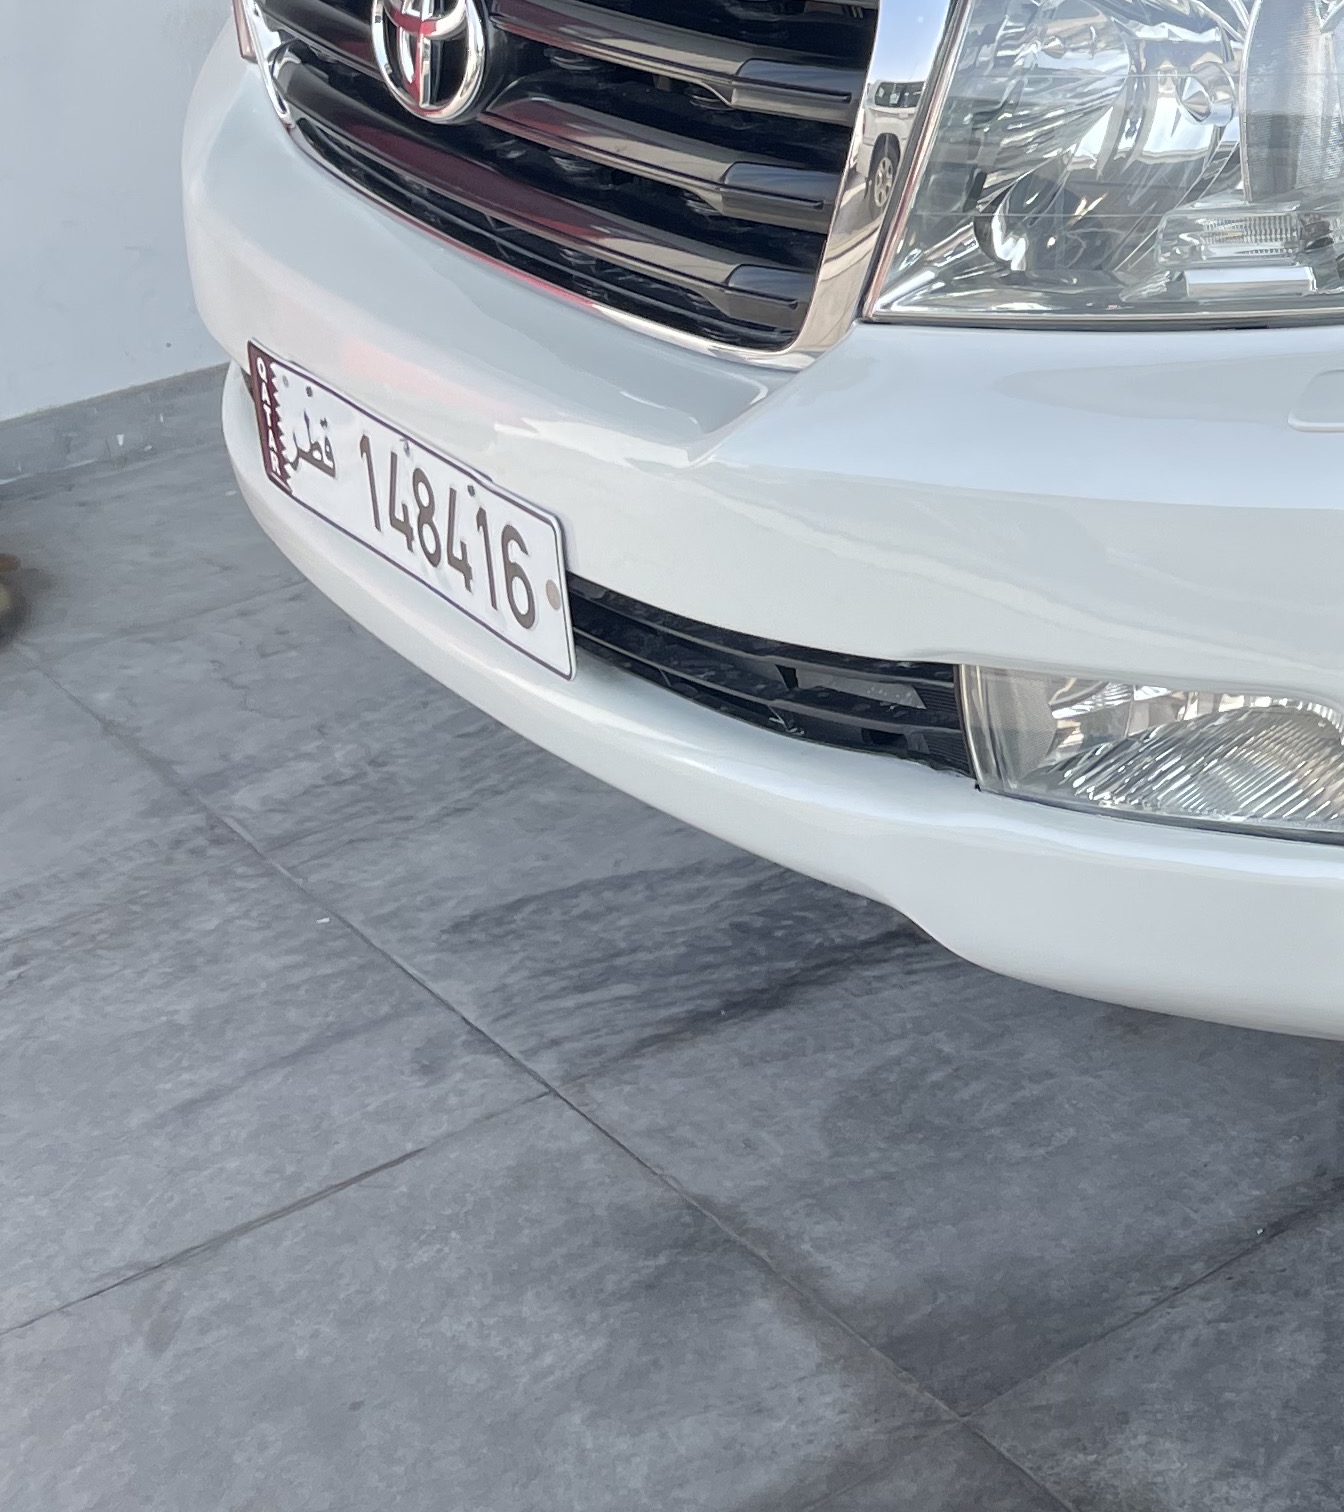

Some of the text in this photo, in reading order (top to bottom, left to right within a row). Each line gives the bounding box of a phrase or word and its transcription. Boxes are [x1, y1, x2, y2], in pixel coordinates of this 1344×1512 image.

[255, 356, 281, 476] QATAR
[289, 409, 337, 479] قطر
[359, 433, 537, 630] 148416
